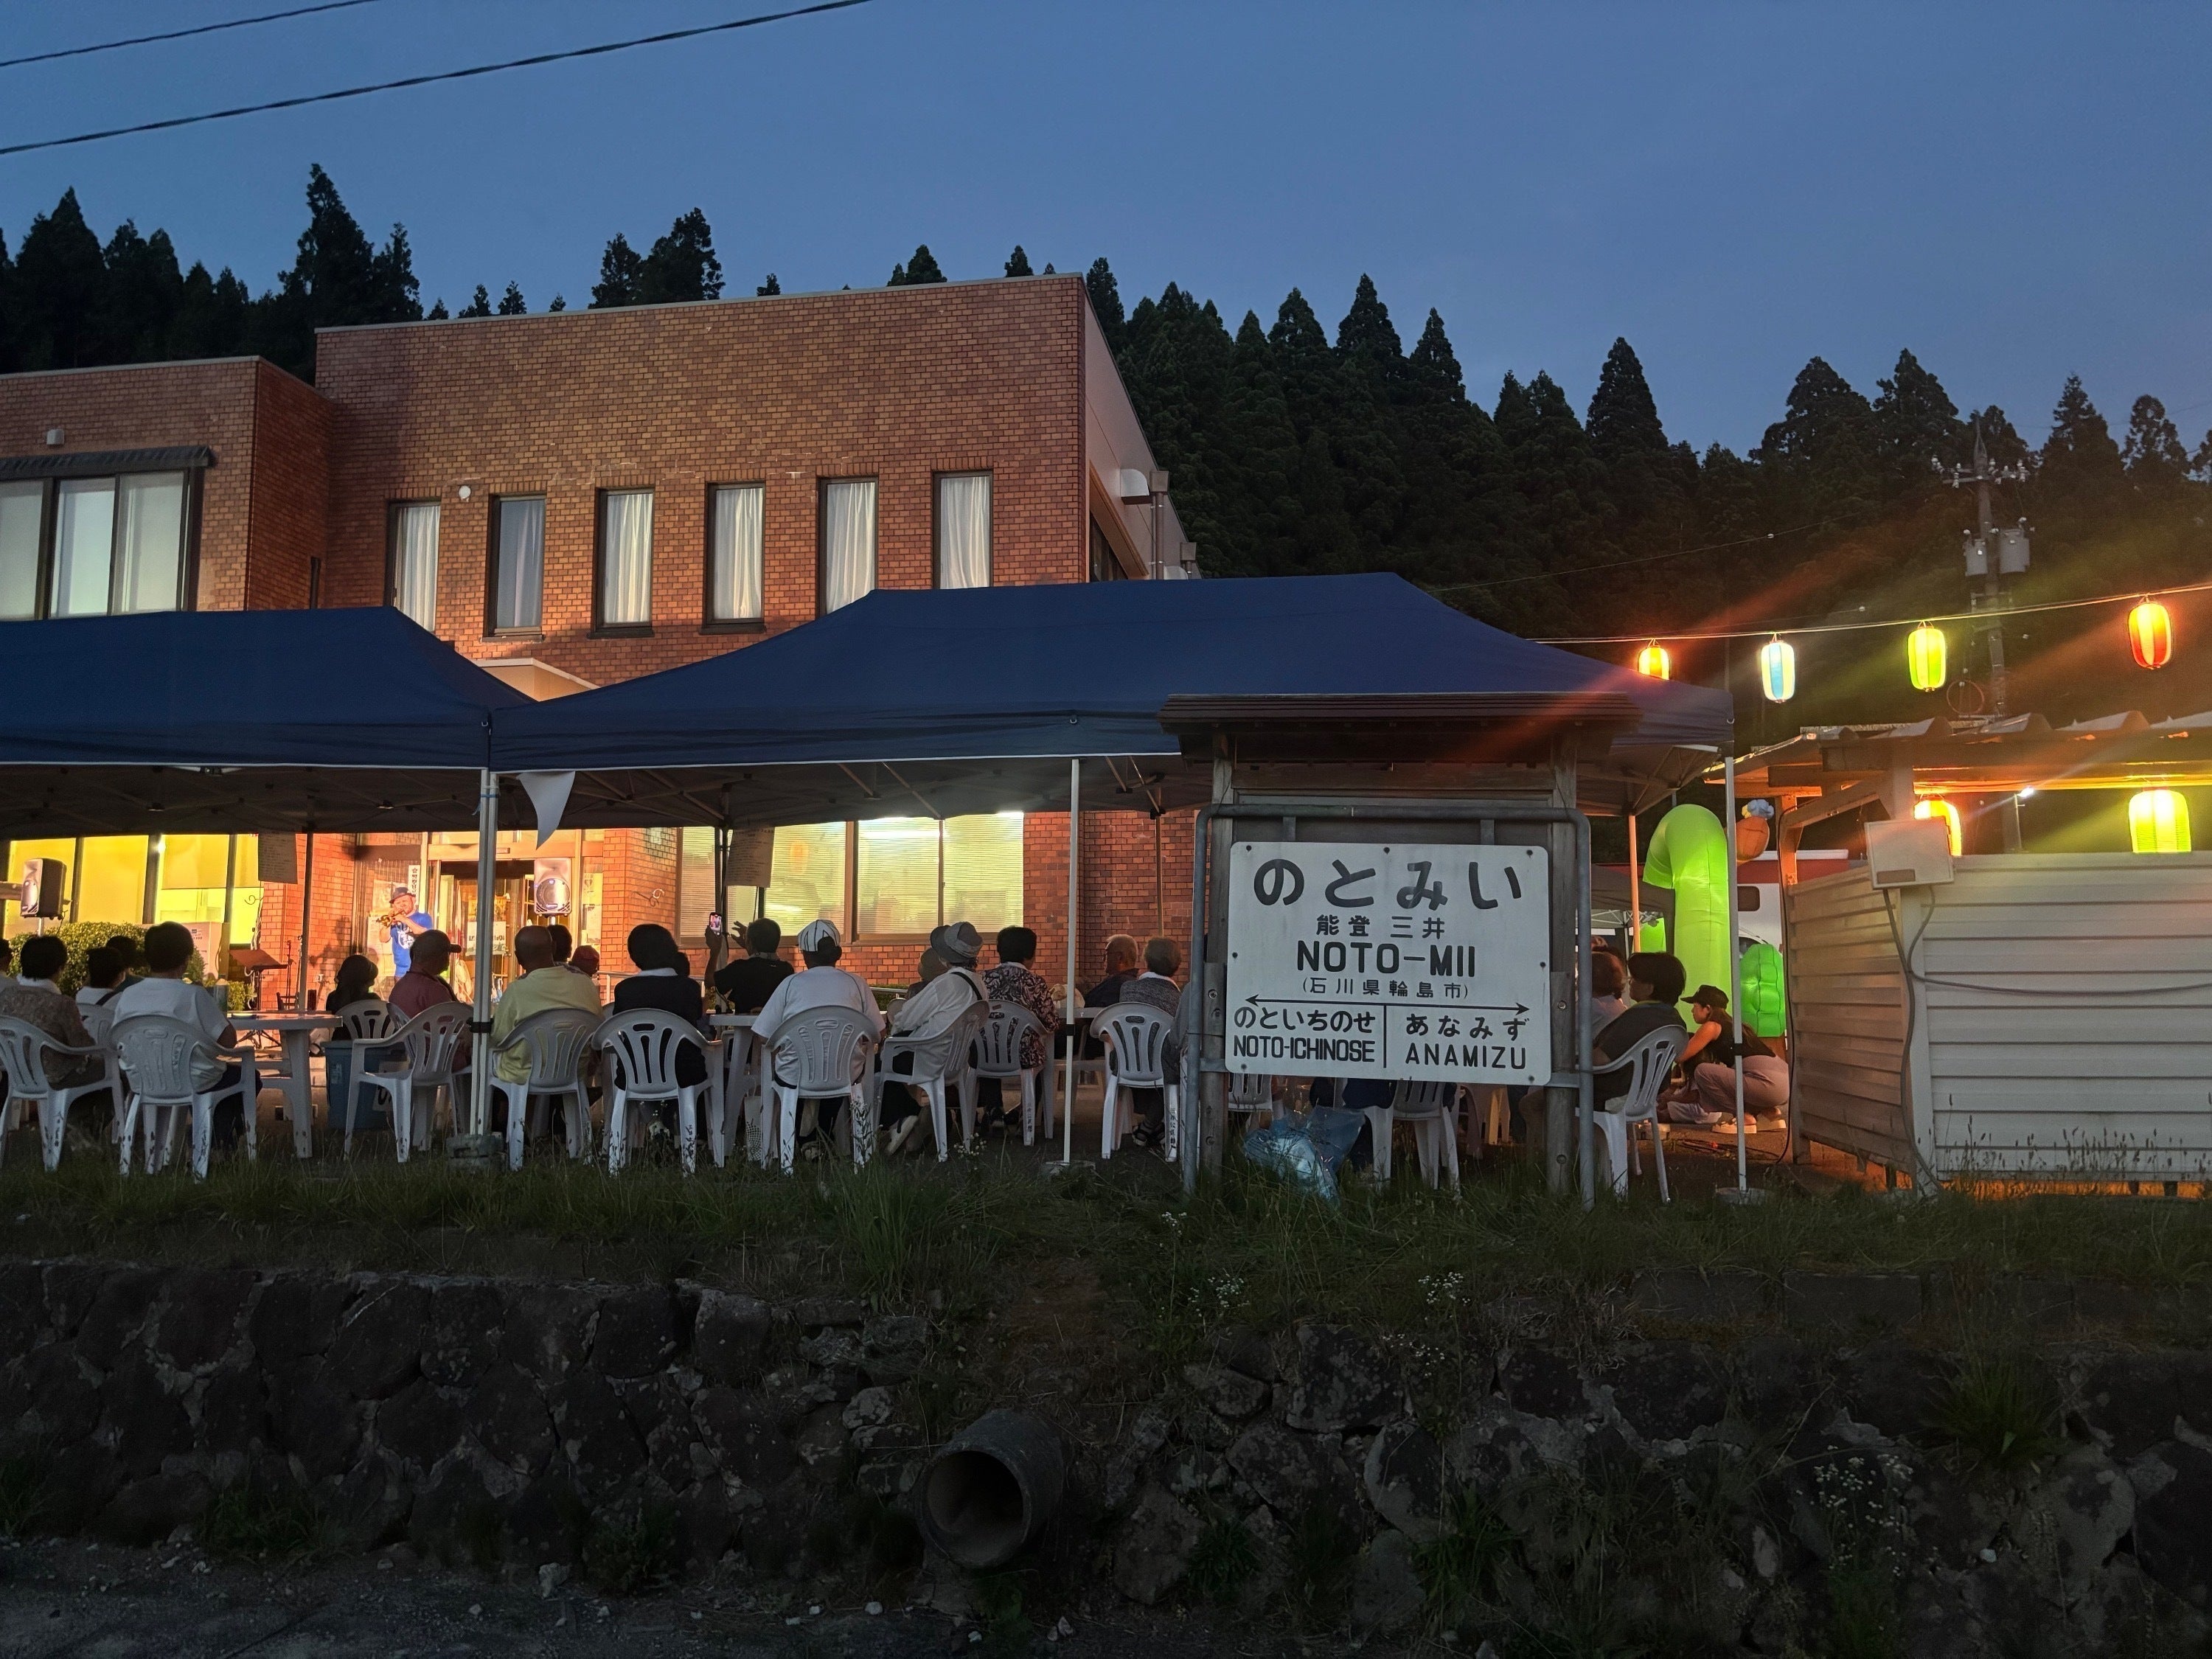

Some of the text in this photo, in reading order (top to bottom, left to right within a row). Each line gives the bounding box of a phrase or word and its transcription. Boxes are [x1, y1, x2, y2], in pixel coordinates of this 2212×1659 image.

[1254, 858, 1521, 911] のとみい
[1298, 940, 1475, 977] NOTO-MII
[1234, 1006, 1376, 1033] のといちのせ
[1406, 1014, 1529, 1041] あなみず
[1234, 1035, 1376, 1062] NOTO-ICHINOSE
[1405, 1043, 1526, 1069] ANAMIZU
